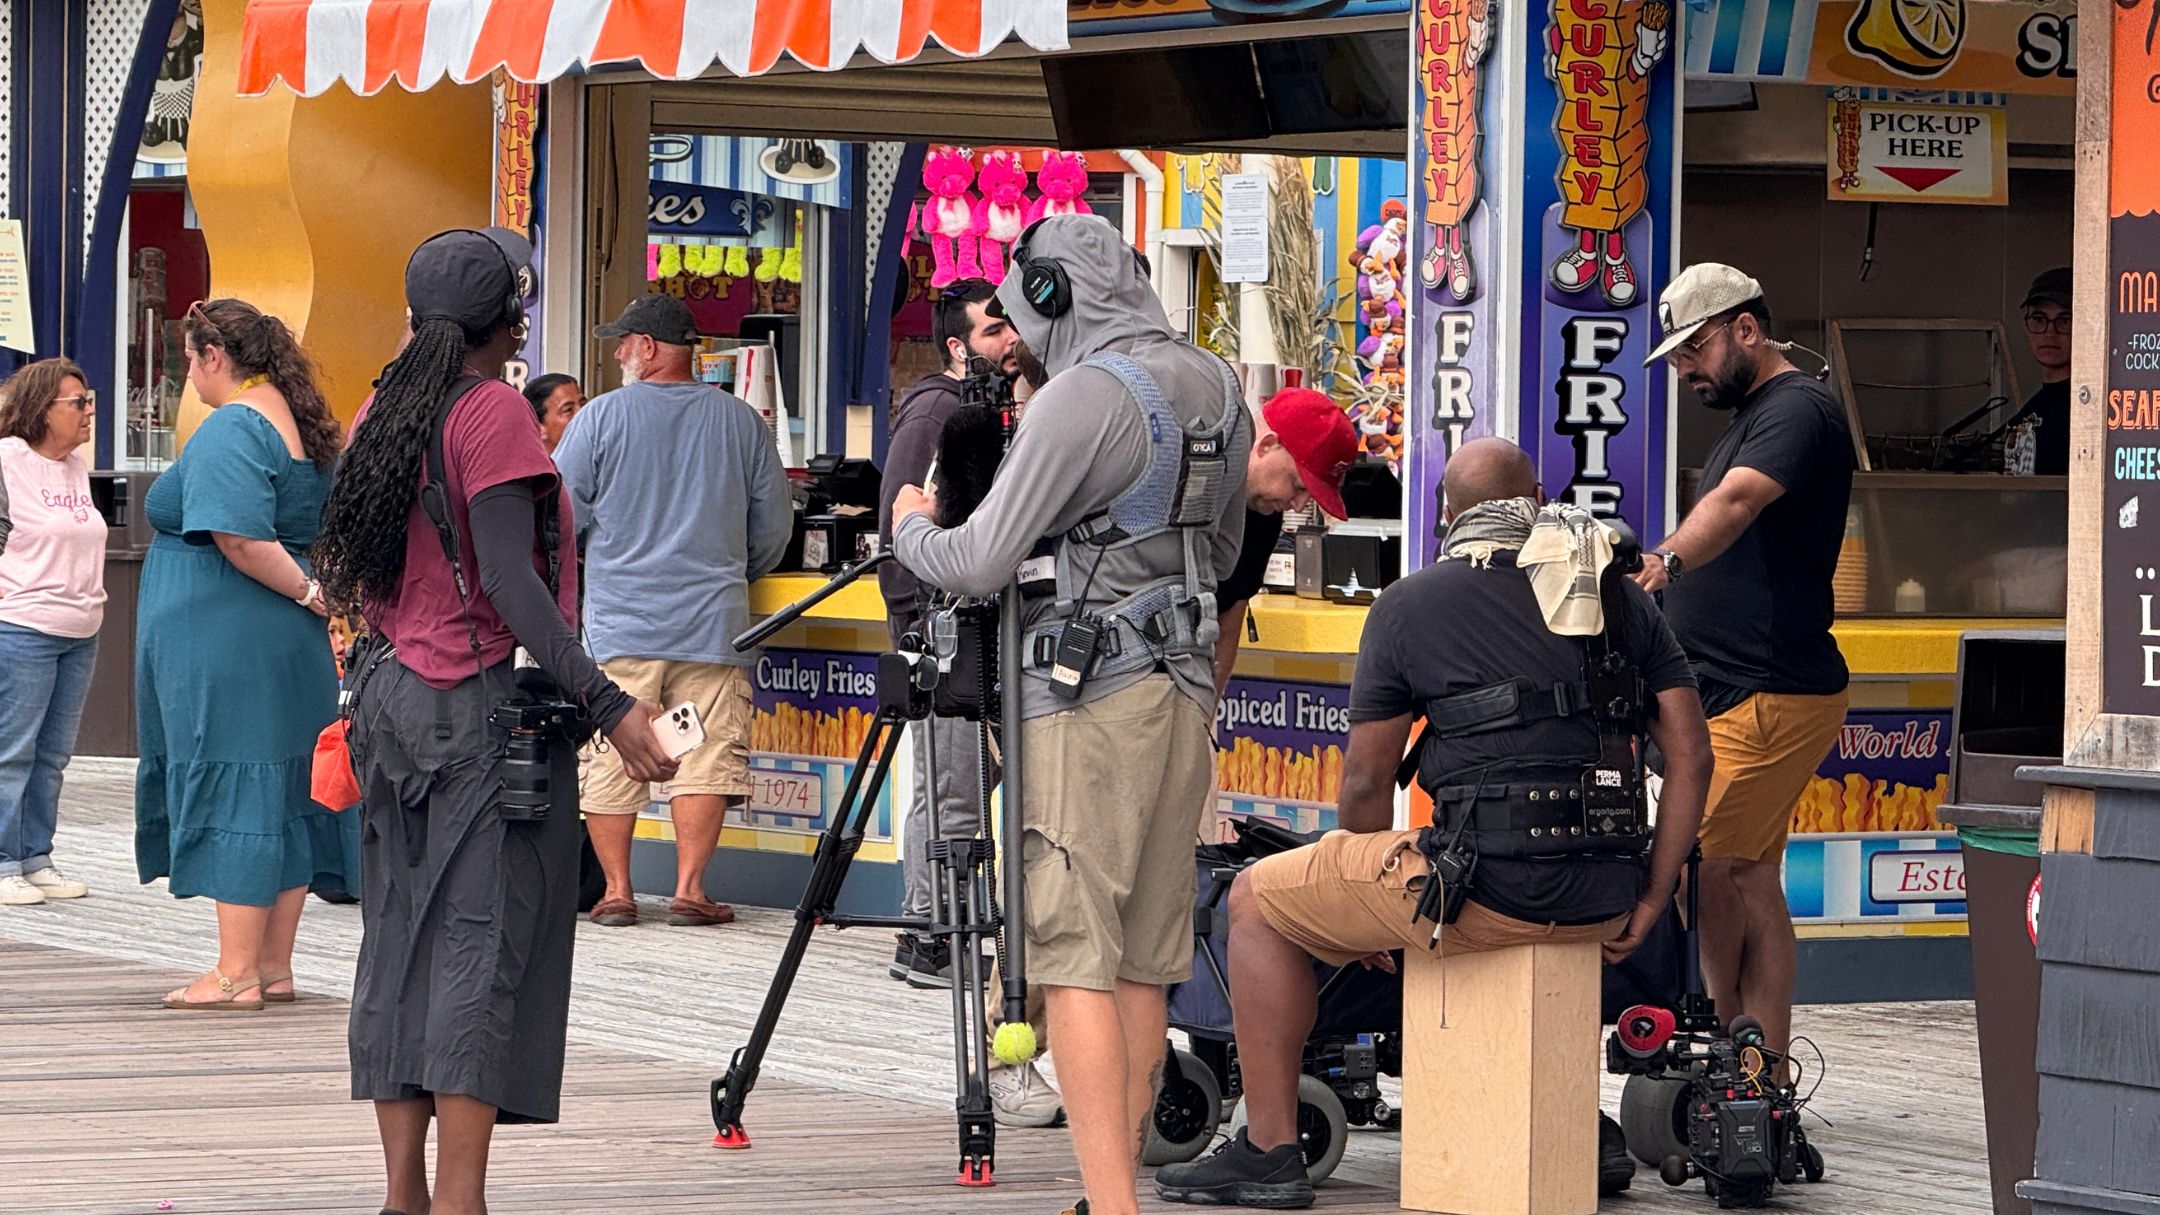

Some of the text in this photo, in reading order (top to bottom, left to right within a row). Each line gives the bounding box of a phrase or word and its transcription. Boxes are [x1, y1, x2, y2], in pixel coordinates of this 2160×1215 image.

[1568, 0, 1609, 205] CURLEY
[1870, 112, 1981, 136] PICK-UP
[1888, 138, 1964, 159] HERE
[2119, 271, 2159, 313] MA
[2125, 352, 2160, 370] COCK
[756, 656, 877, 700] Curley Fries
[1294, 692, 1350, 733] Fries
[1838, 720, 1941, 760] World
[1595, 769, 1622, 779] PERMA
[1595, 778, 1623, 788] LANCE
[763, 777, 809, 810] 1974
